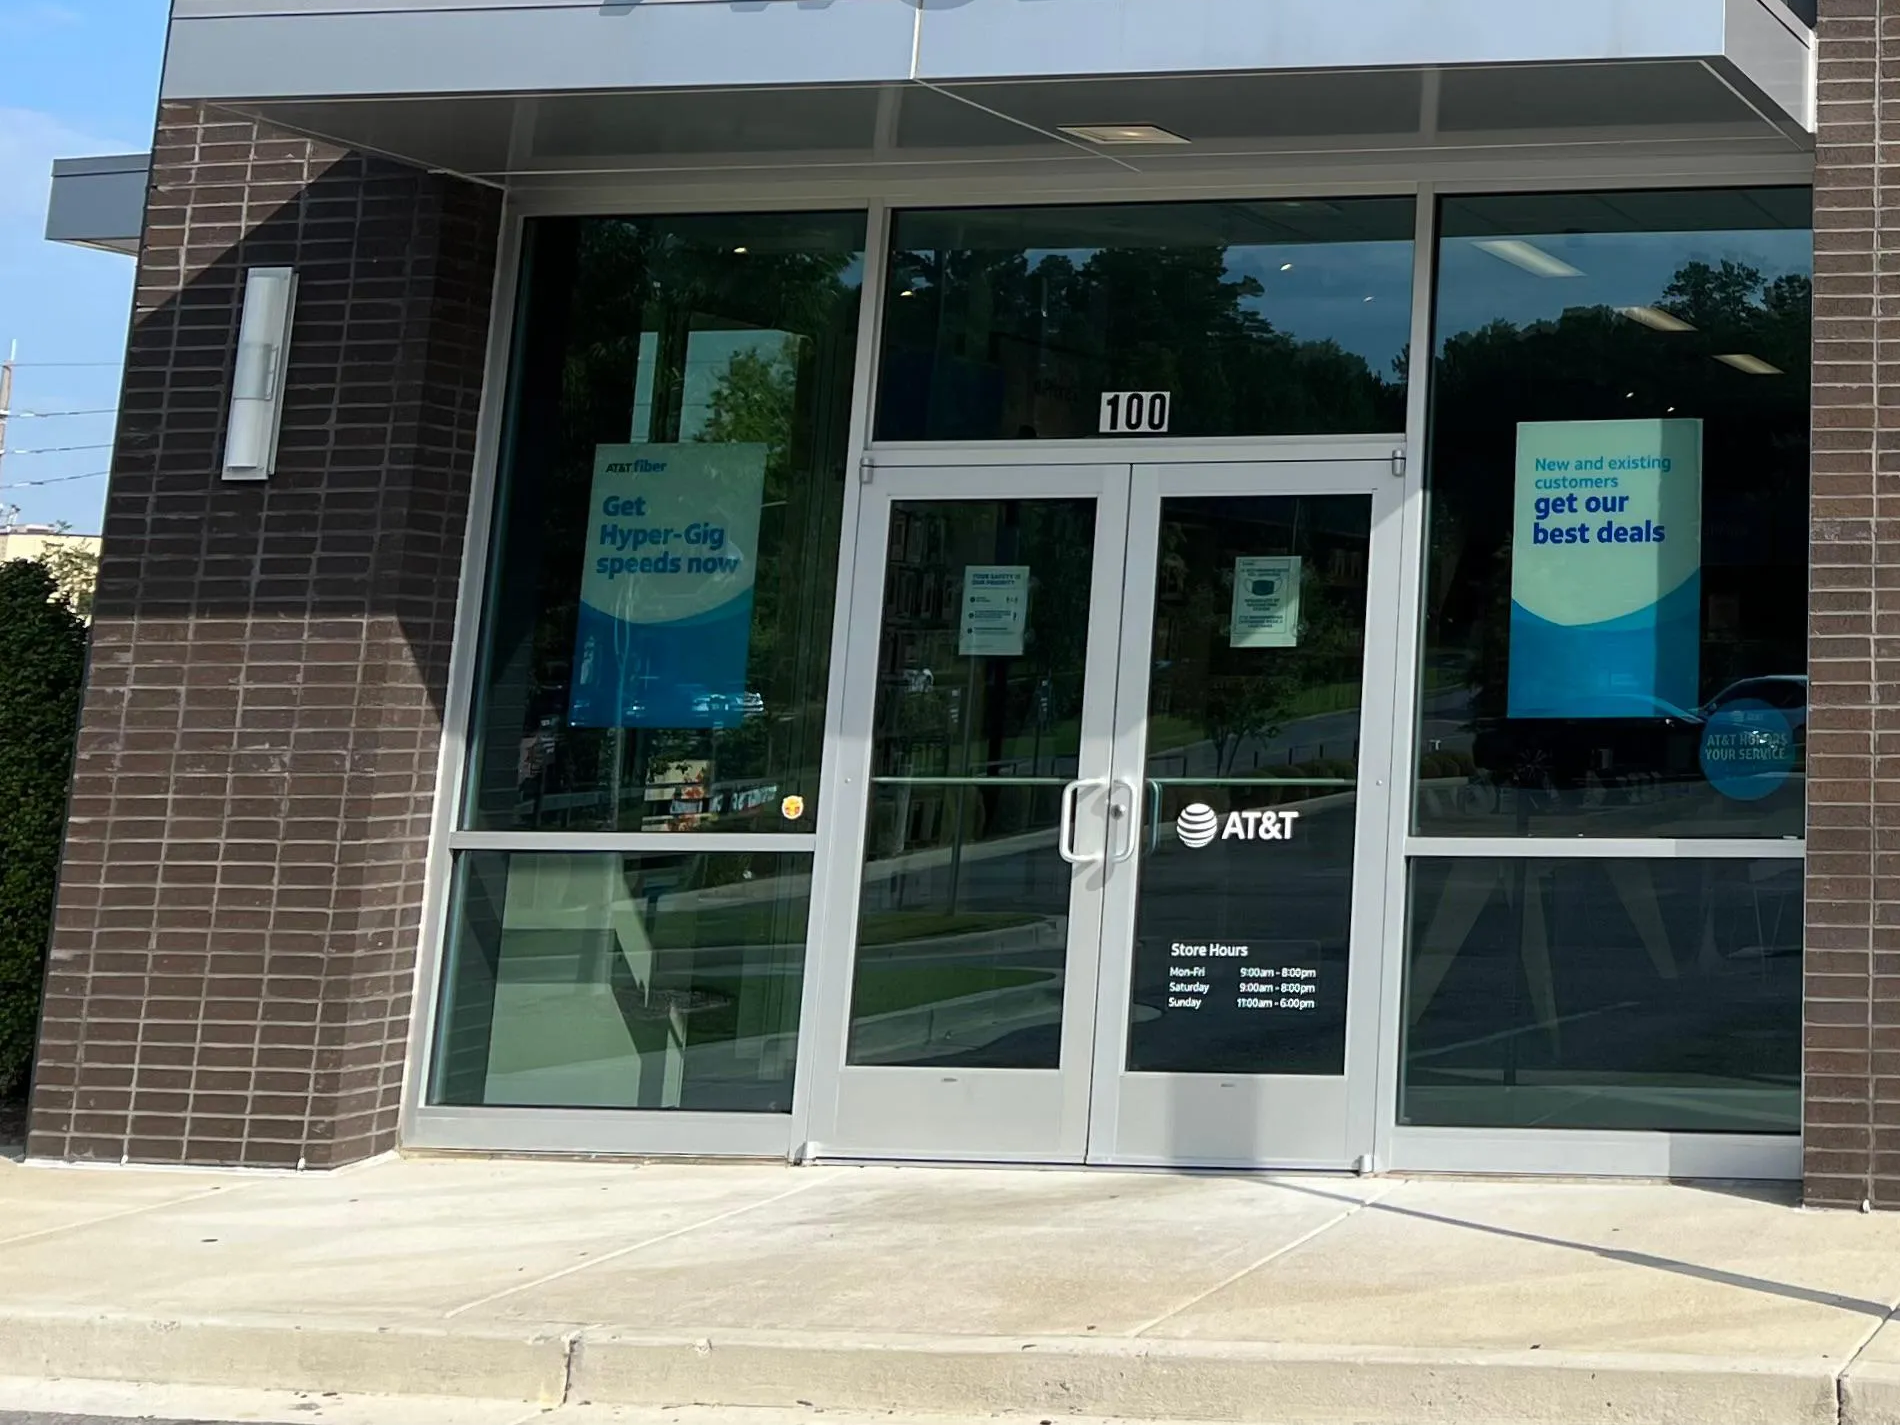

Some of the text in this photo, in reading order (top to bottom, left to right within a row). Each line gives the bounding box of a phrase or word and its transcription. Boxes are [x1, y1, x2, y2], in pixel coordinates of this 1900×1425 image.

[1106, 392, 1167, 430] 100
[605, 459, 667, 473] AT&T fiber
[1535, 455, 1672, 472] New and existing
[1535, 476, 1619, 490] customers
[602, 495, 646, 517] Get
[1534, 493, 1630, 520] get our
[600, 522, 725, 551] Hyper-Gig
[1533, 520, 1666, 544] best deals
[596, 551, 740, 579] speeds now
[1707, 734, 1737, 747] AT&T
[1705, 747, 1786, 762] YOUR SERVICE
[1221, 811, 1299, 840] AT&T
[1171, 943, 1249, 957] Store Hours
[1169, 966, 1206, 977] Mon-Fri
[1240, 967, 1275, 978] 9:00am
[1281, 967, 1317, 980] 8:00pm
[1169, 982, 1210, 994] Saturday
[1239, 983, 1274, 993] 9:00am
[1280, 983, 1316, 995] 8:00pm
[1168, 997, 1202, 1010] Sunday
[1236, 998, 1273, 1008] 11:00am
[1279, 998, 1315, 1010] 6:00pm
